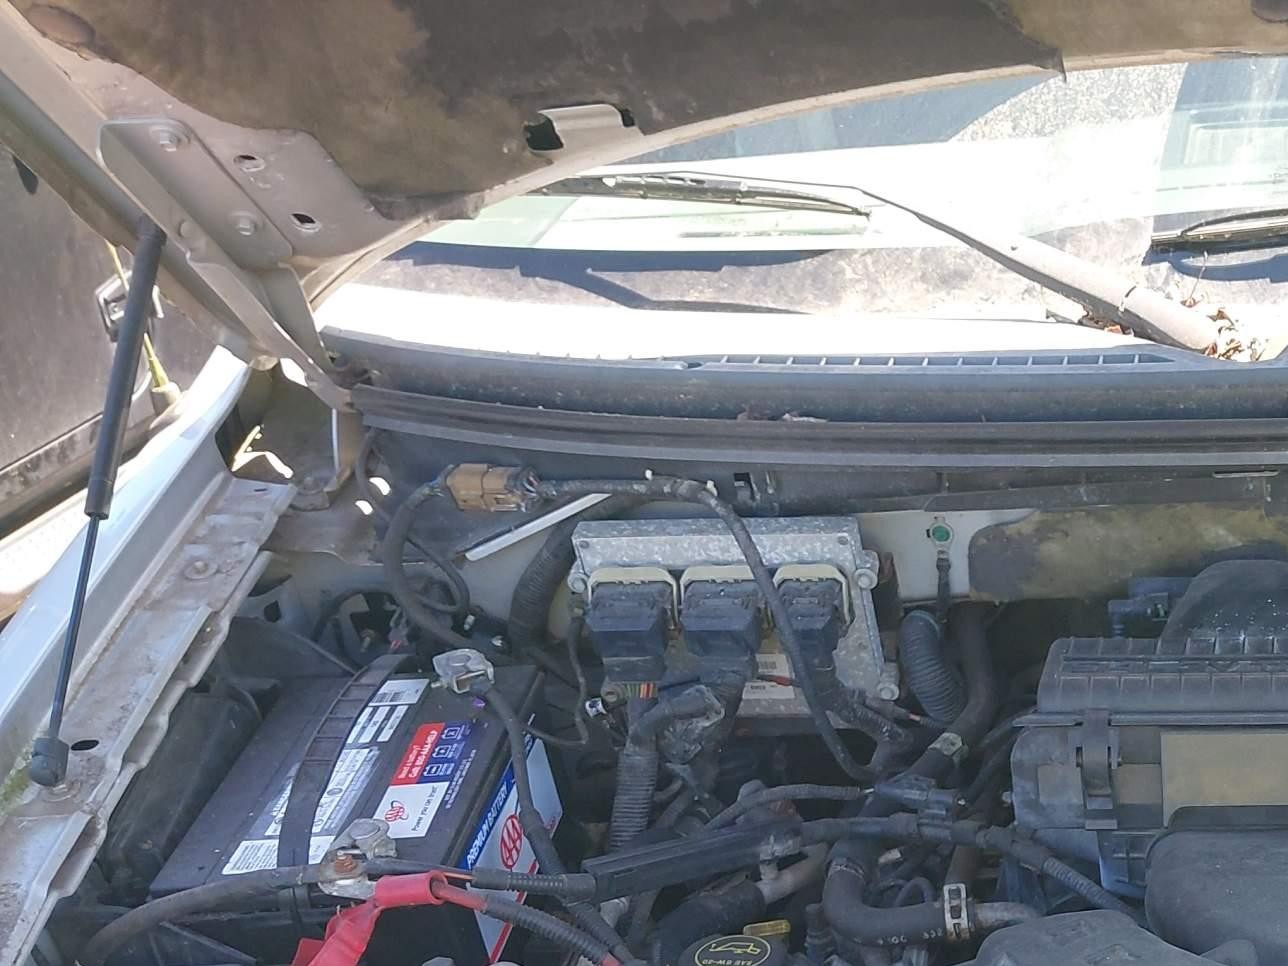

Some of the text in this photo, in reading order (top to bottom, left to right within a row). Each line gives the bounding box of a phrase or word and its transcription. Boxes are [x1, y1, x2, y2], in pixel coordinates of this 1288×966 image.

[465, 782, 509, 868] PREMIUM BATTERY
[502, 818, 523, 867] AAA
